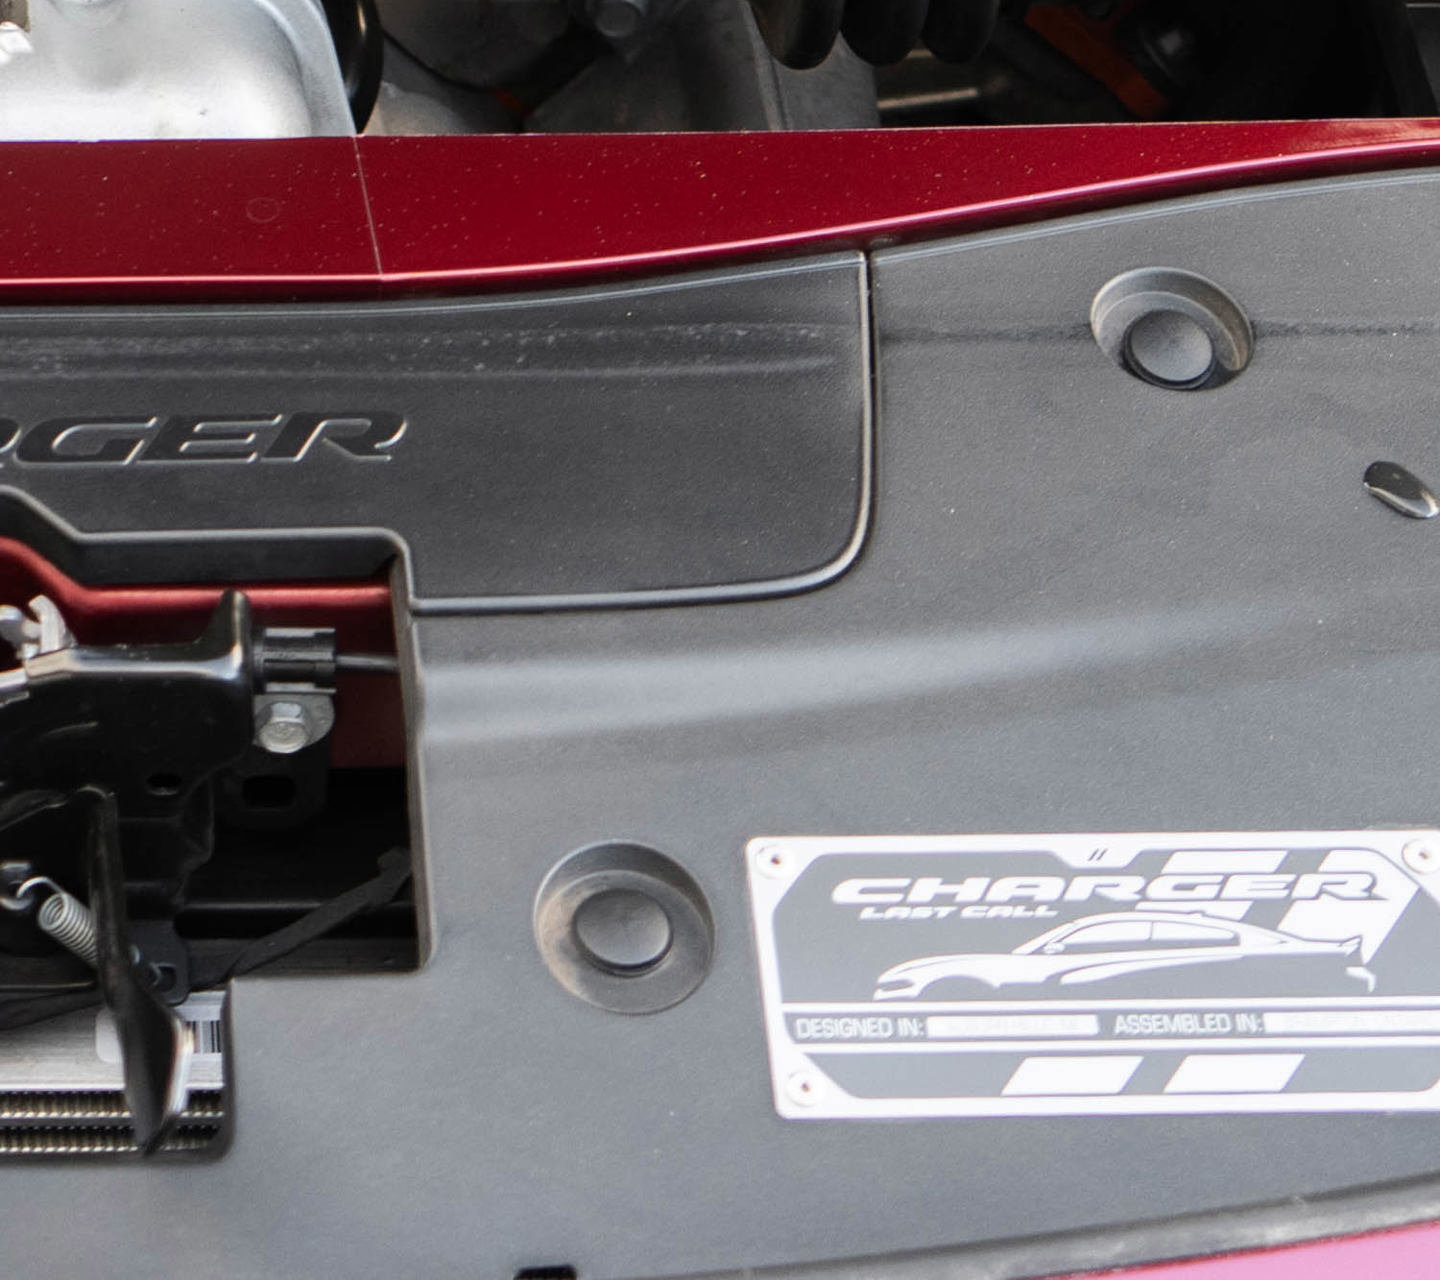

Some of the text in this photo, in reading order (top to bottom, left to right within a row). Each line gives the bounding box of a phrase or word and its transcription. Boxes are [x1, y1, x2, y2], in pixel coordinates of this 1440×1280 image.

[831, 871, 1377, 907] CHARGER
[858, 904, 1060, 921] LAST CALL
[794, 1017, 894, 1041] DESIGNED
[896, 1016, 925, 1038] IN:
[1112, 1012, 1233, 1037] ASSEMBLED
[1235, 1012, 1265, 1035] IN:
